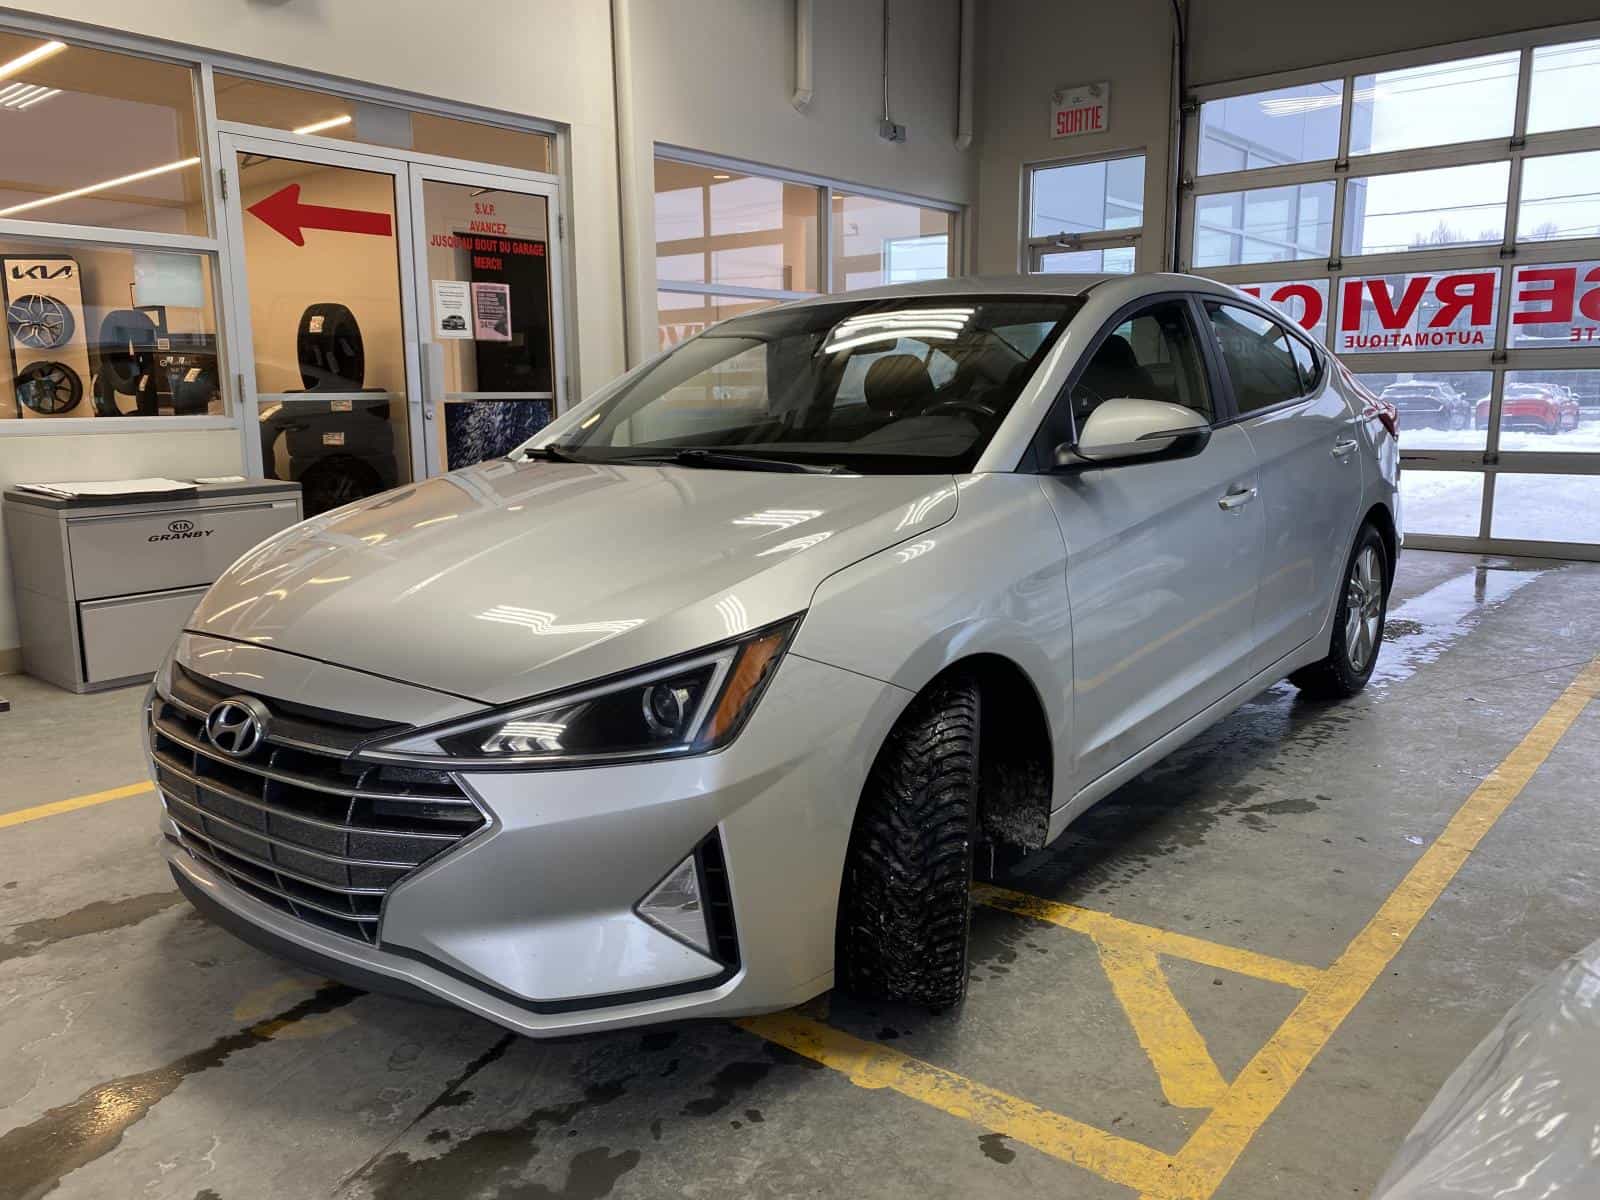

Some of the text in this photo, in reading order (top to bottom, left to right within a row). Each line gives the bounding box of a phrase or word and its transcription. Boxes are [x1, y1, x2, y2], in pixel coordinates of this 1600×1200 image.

[1056, 105, 1103, 135] SORTIE
[469, 221, 507, 235] AVANCEZ
[475, 239, 497, 252] BOUT
[499, 241, 511, 254] DU
[512, 242, 544, 257] GARAGE
[148, 529, 215, 543] GRANBY
